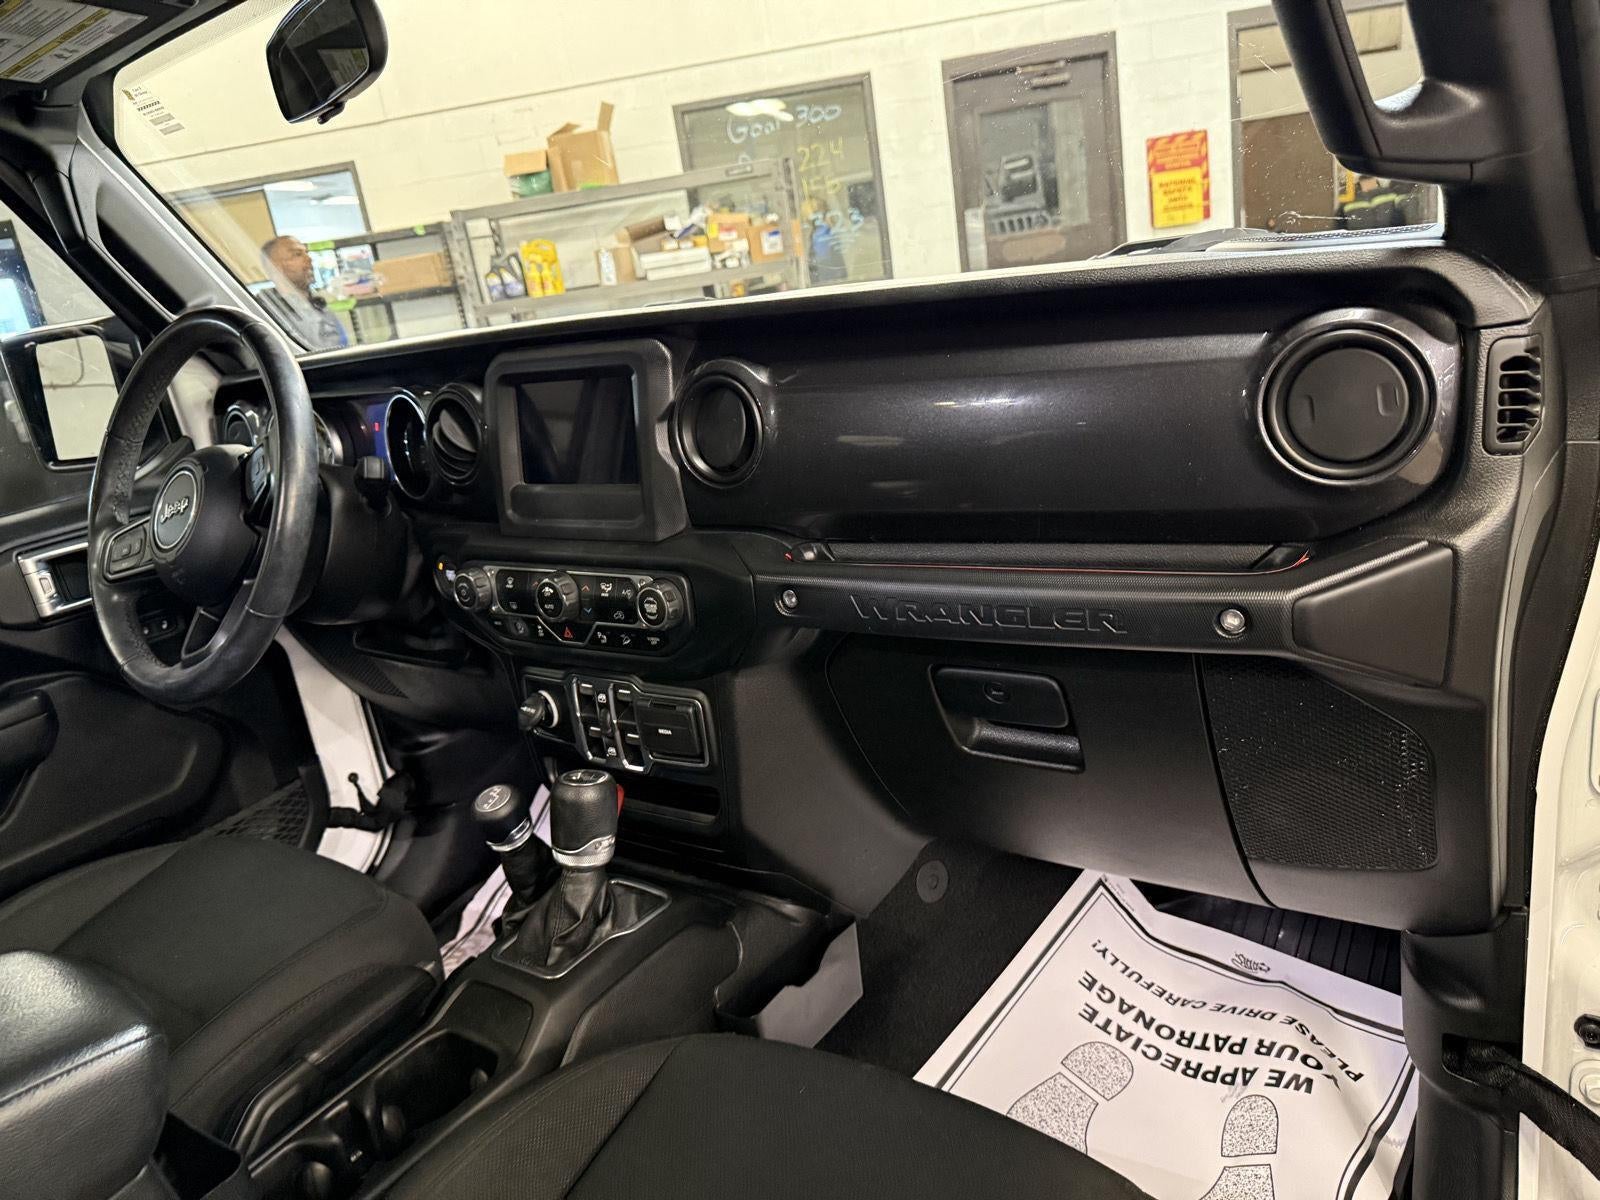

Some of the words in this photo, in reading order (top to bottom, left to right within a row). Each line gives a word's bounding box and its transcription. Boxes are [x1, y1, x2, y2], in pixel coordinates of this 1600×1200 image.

[727, 114, 781, 144] Goal
[796, 104, 842, 127] 300
[797, 136, 844, 171] 224
[160, 496, 189, 524] Jeep
[849, 594, 1128, 635] WRANGLER
[1090, 938, 1207, 1010] CAREFULLY!
[1077, 970, 1249, 1057] PATRONAGE
[1208, 1003, 1278, 1021] DRIVE
[1077, 1001, 1260, 1087] APPRECIATE
[1256, 1037, 1341, 1091] YOUR
[1278, 1014, 1365, 1083] PLEASE
[1263, 1068, 1315, 1095] WE
